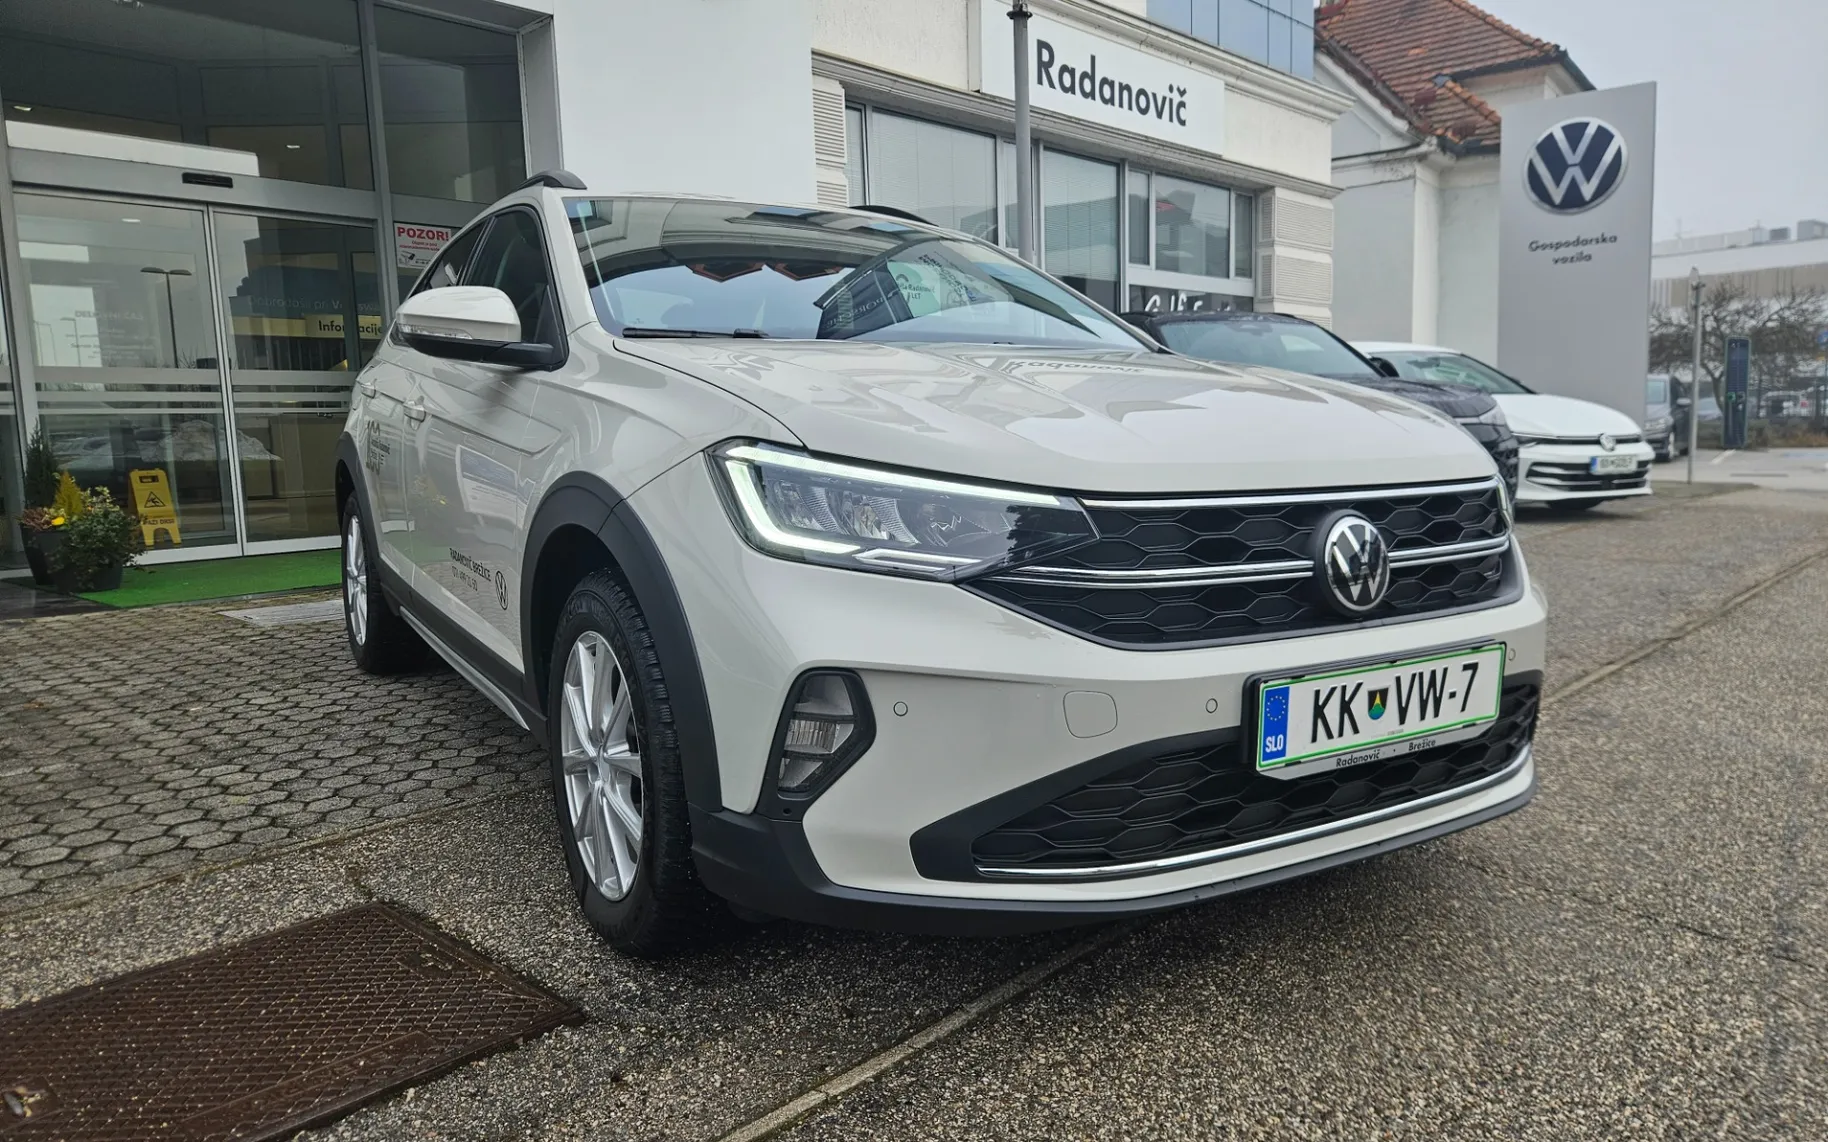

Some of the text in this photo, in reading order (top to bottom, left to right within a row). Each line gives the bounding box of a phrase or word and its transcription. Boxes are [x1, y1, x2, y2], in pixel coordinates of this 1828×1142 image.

[1036, 38, 1187, 127] Radanovič
[397, 226, 449, 241] POZOR!
[1528, 233, 1618, 252] Gospodarska
[1552, 251, 1592, 264] vozila
[1265, 660, 1480, 754] SLO KK VW-7
[1336, 749, 1380, 768] Radanovič
